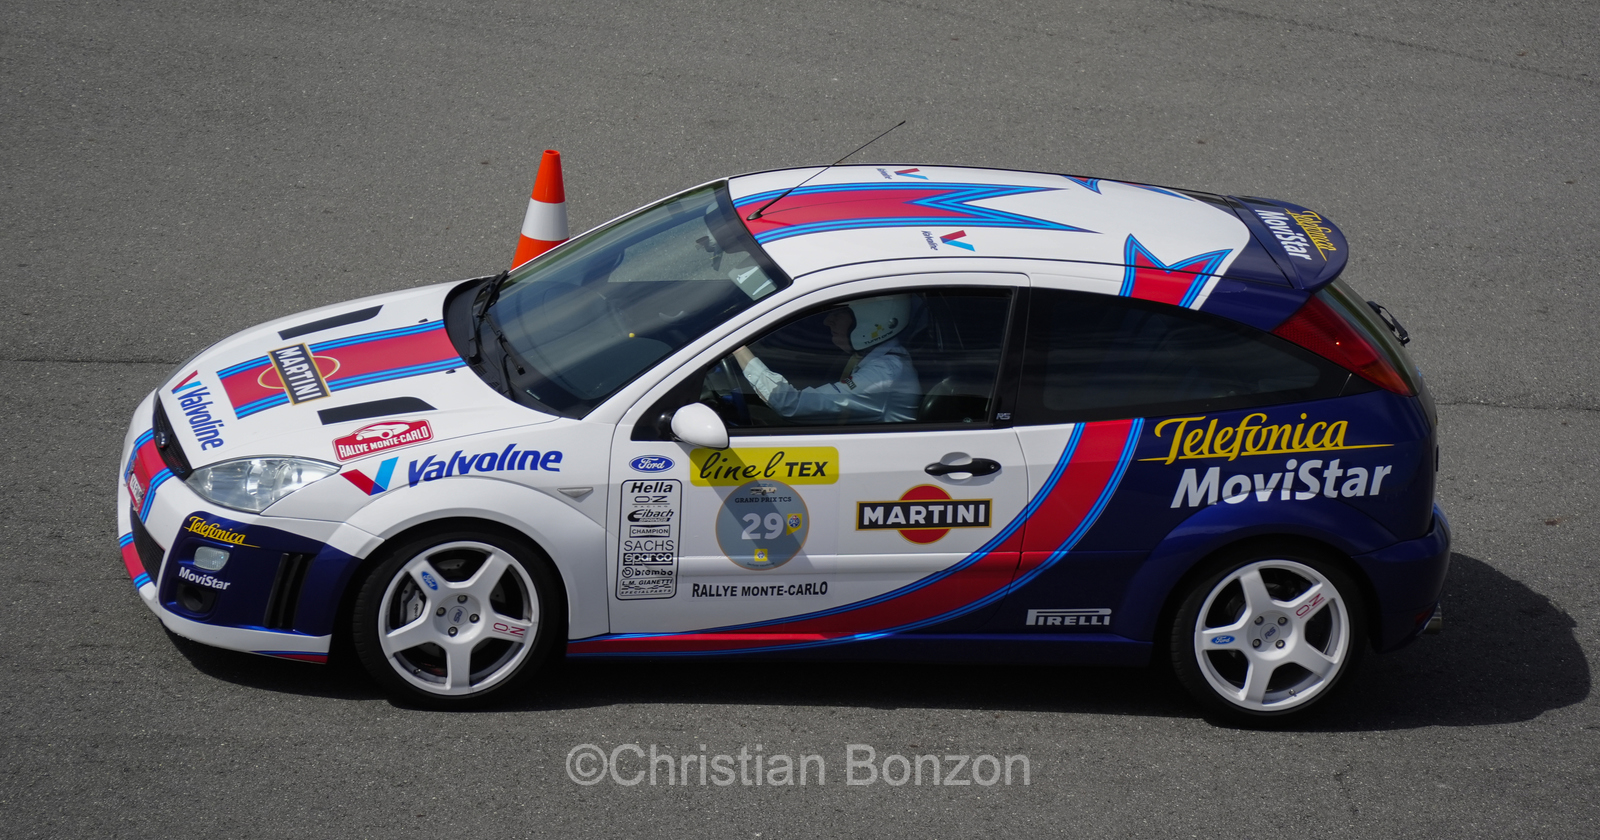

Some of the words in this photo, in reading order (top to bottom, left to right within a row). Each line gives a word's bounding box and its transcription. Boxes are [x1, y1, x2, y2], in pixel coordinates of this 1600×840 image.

[1254, 209, 1312, 260] MoviStar
[275, 346, 323, 401] MARTINI
[177, 386, 224, 451] Valvoline
[996, 412, 1011, 420] RS
[338, 443, 369, 458] RALLYE
[370, 425, 429, 449] MONTE-CARLO
[408, 443, 563, 488] Valvoline
[637, 458, 666, 469] Ford
[785, 461, 828, 477] TEX
[630, 482, 673, 493] Hella
[1170, 458, 1392, 509] MoviStar
[627, 509, 674, 522] Eibach
[863, 504, 986, 525] MARTINI
[742, 512, 784, 540] 29
[624, 540, 674, 551] SACHS
[624, 553, 672, 565] sparco
[178, 566, 231, 590] MoviStar
[634, 568, 673, 576] brembo
[692, 583, 737, 598] RALLYE
[741, 581, 828, 597] MONTE-CARLO
[1026, 608, 1112, 626] PIRELLI
[1214, 636, 1232, 644] Ford
